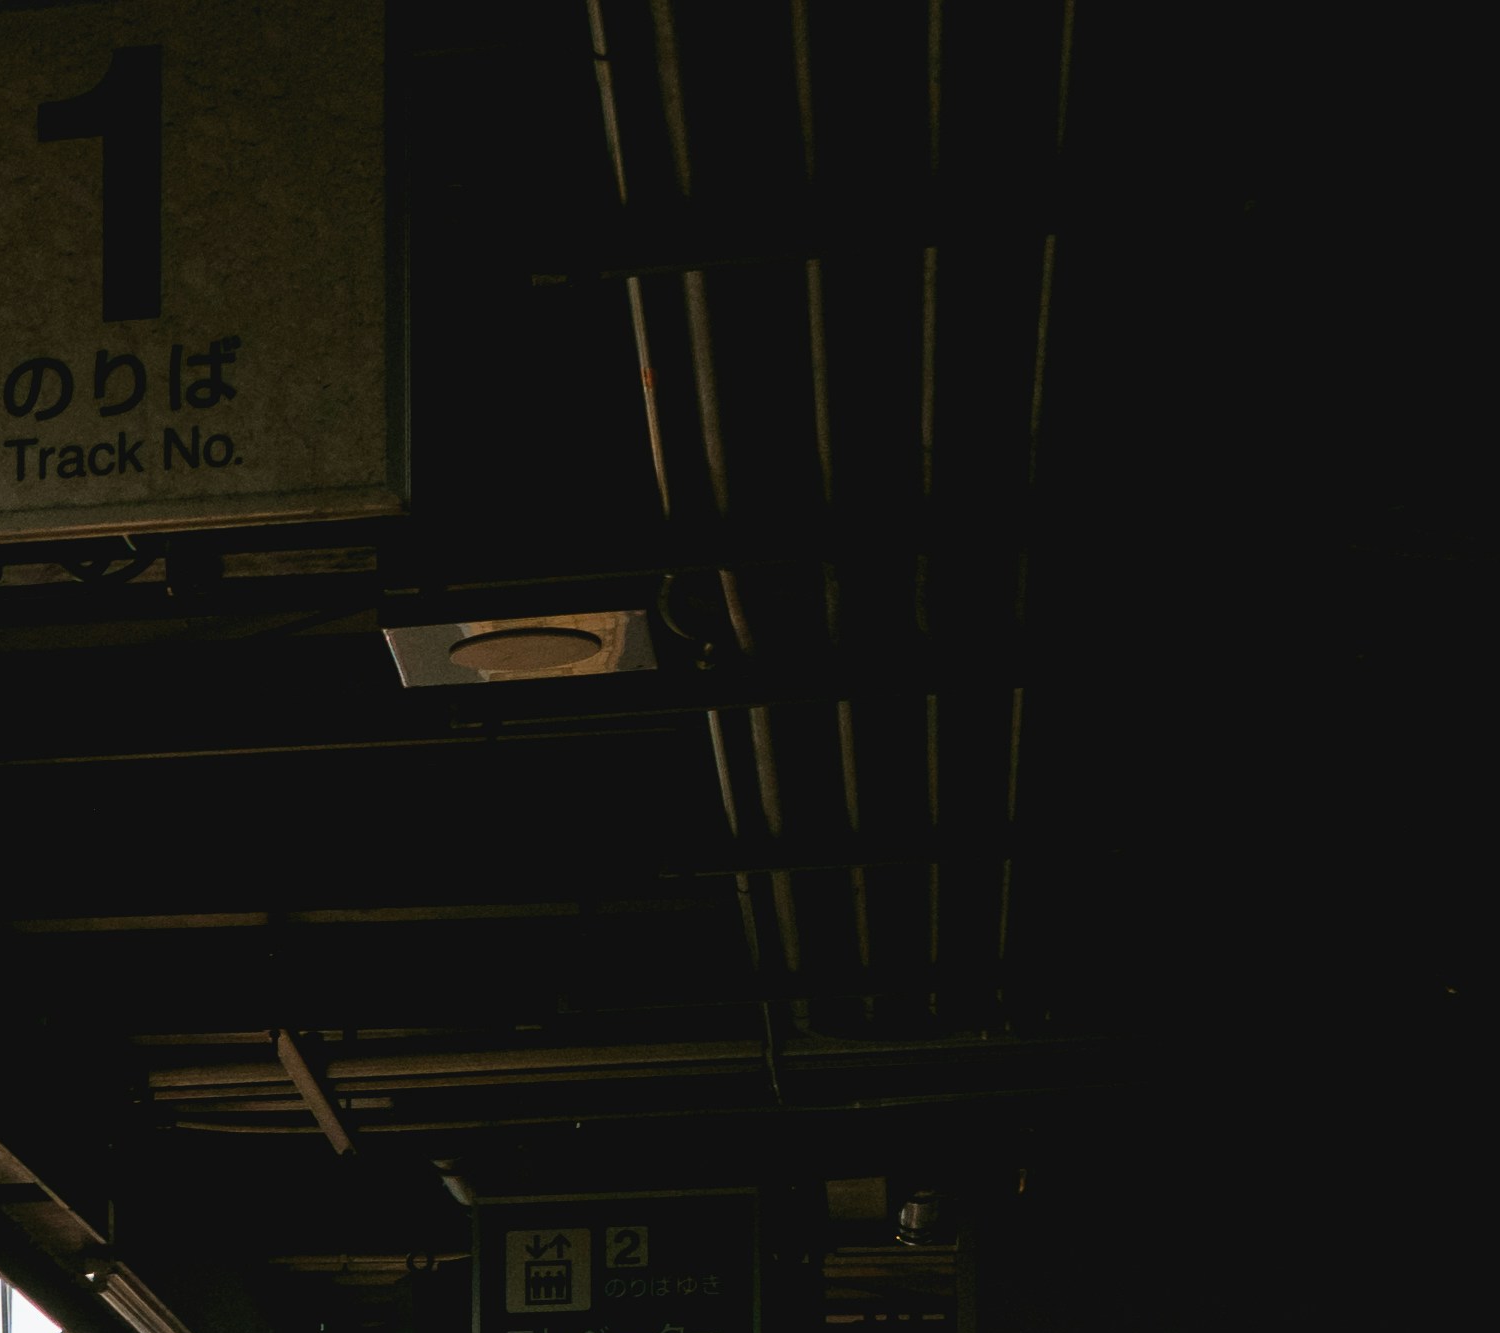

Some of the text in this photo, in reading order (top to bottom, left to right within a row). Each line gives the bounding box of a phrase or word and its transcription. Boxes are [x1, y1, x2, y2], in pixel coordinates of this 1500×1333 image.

[37, 44, 162, 322] 1
[2, 335, 241, 421] のりば
[4, 425, 243, 481] Track No.
[613, 1230, 641, 1266] 2
[605, 1274, 723, 1299] のりばゆき
